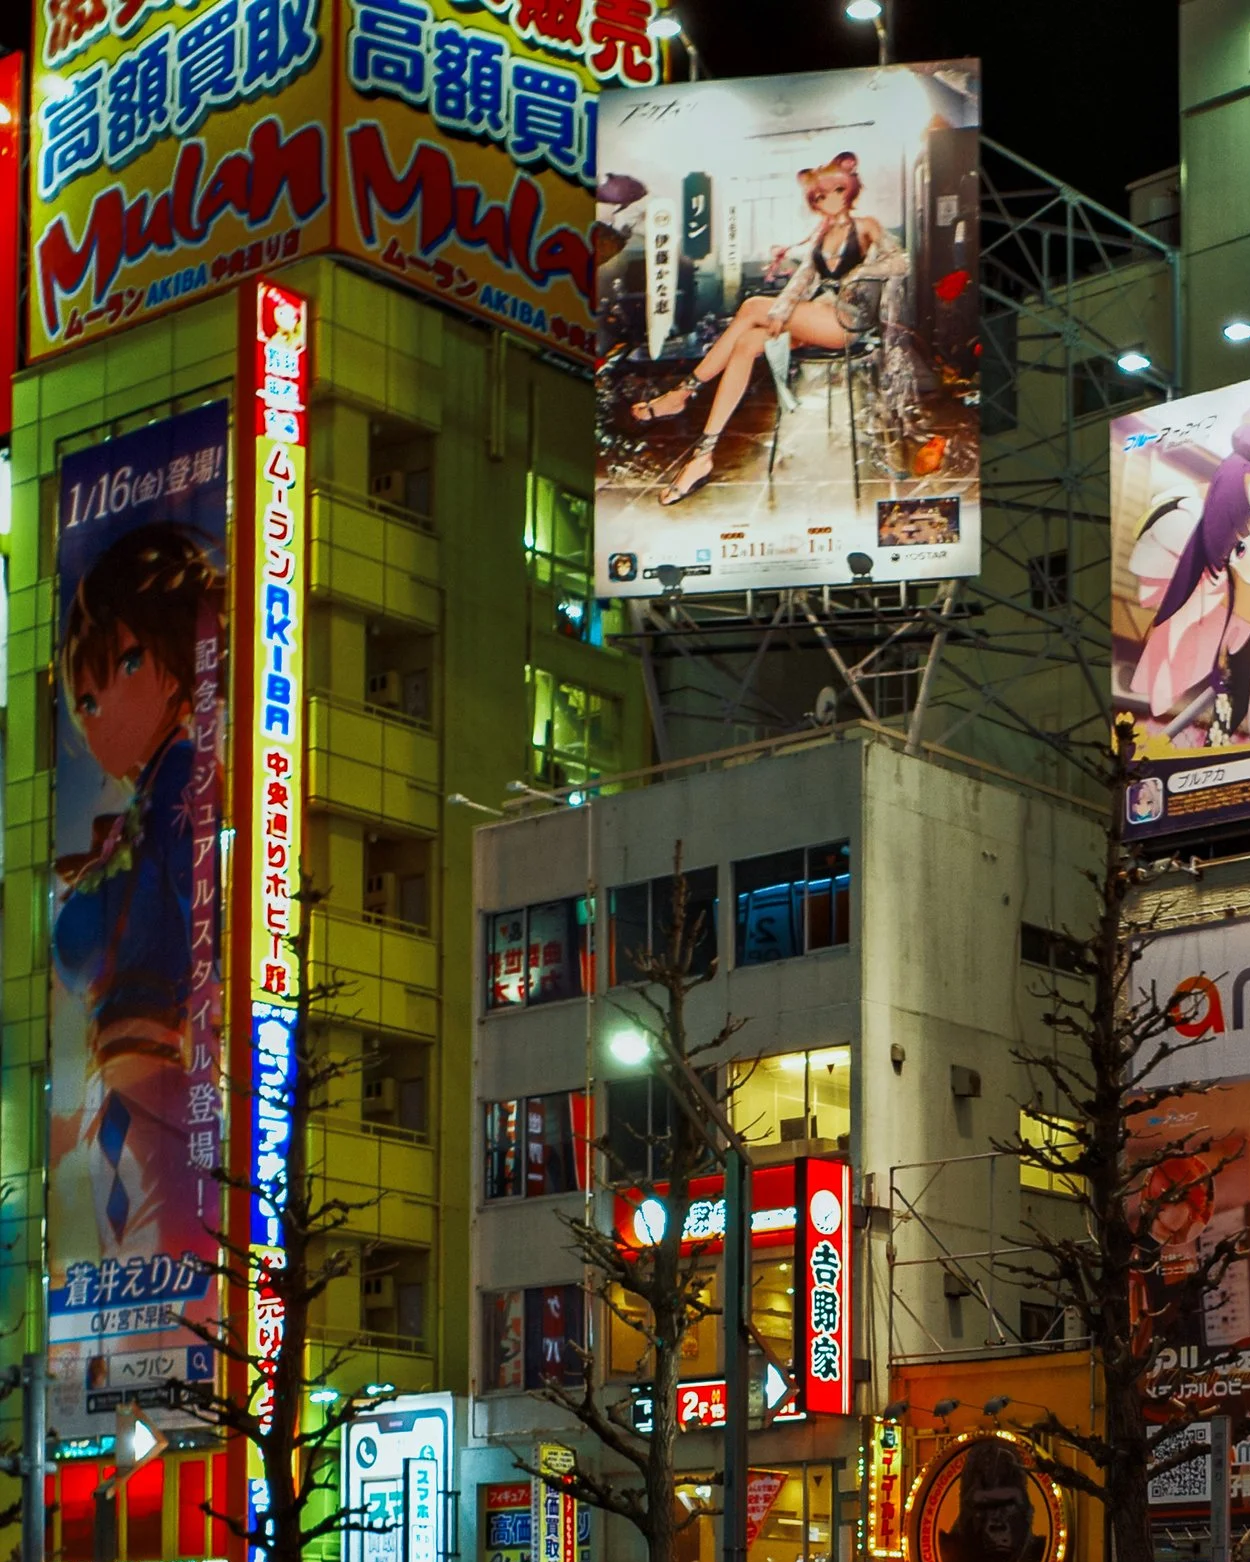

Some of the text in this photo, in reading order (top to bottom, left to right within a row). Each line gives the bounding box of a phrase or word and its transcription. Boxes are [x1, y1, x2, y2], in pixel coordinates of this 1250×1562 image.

[41, 0, 316, 194] 高額買取
[350, 0, 598, 180] 高額買
[38, 118, 327, 338] Mulan
[346, 120, 598, 318] Mula
[690, 193, 708, 239] リン
[63, 287, 146, 340] ムーラン
[145, 263, 208, 307] AKIBA
[382, 237, 479, 297] ムーラン
[479, 285, 549, 334] AKIBA
[653, 233, 672, 315] 伊藤かな恵
[265, 446, 295, 584] ムーラン
[264, 583, 292, 738] AKIBA
[1176, 766, 1227, 789] ブルアカ
[65, 1252, 203, 1308] 蒼井えりか
[121, 1355, 175, 1378] ヘブバン
[416, 1469, 430, 1519] スマホ
